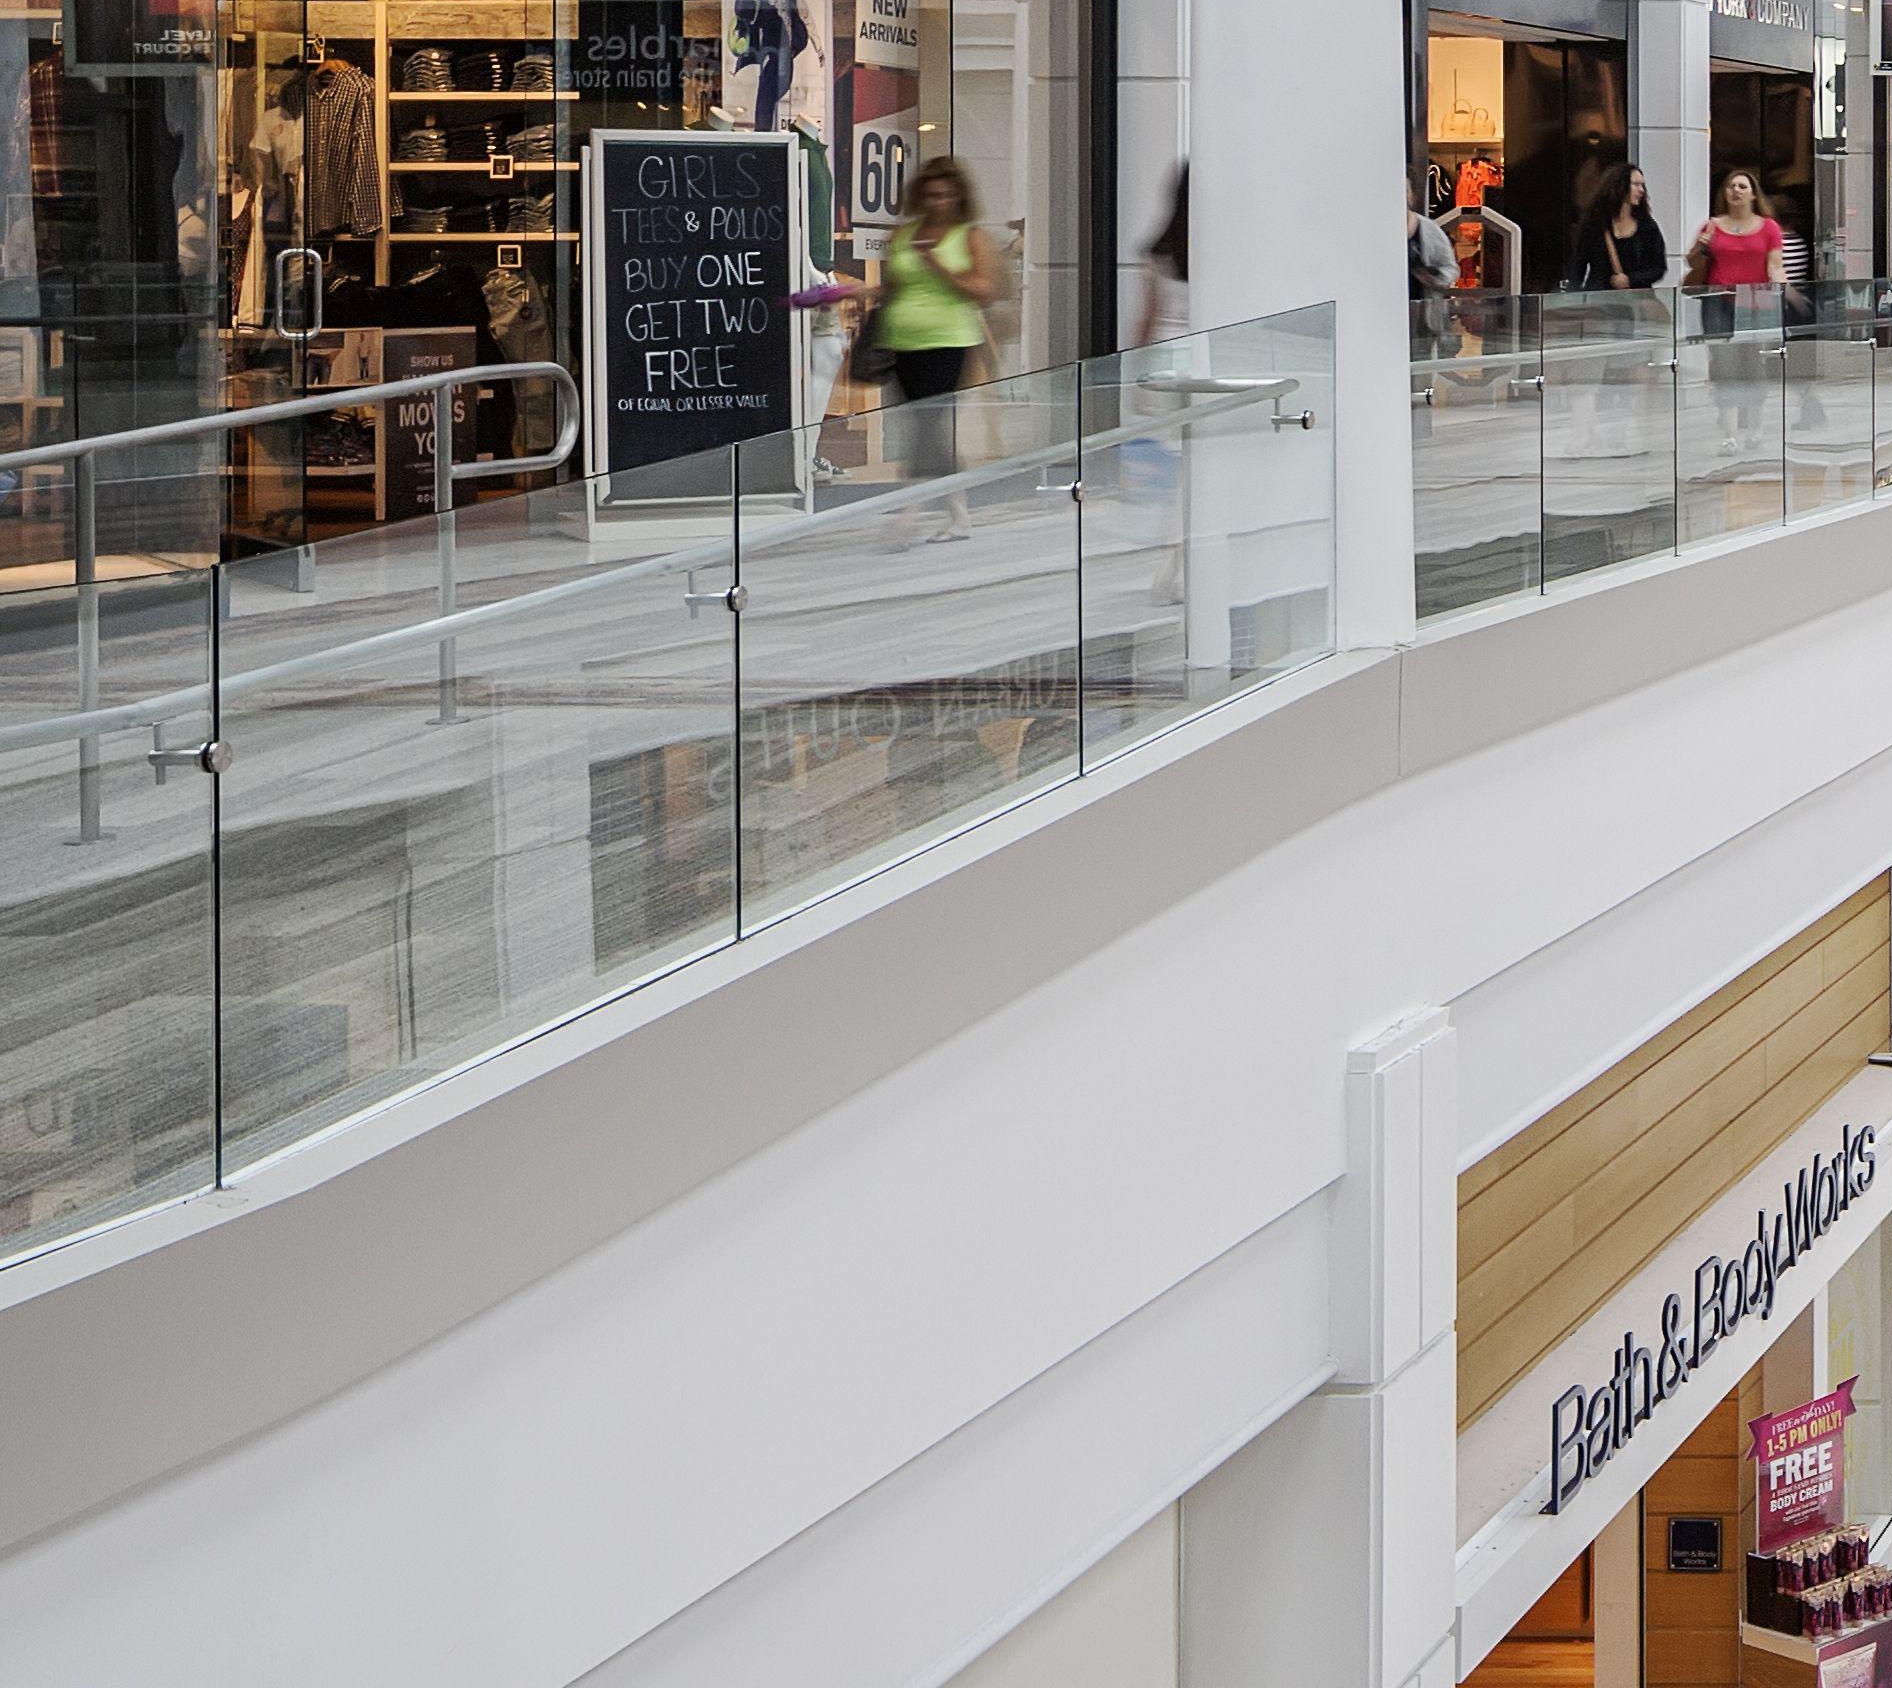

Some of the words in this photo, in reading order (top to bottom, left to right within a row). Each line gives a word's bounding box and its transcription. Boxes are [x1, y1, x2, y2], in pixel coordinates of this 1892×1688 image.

[859, 21, 918, 47] ARRIVALS
[638, 153, 760, 198] GIRLS
[612, 205, 683, 244] TEES
[684, 211, 700, 232] &
[710, 205, 784, 241] POLOS
[624, 255, 688, 293] BUY
[697, 251, 765, 288] ONE
[625, 300, 687, 342] GET
[695, 297, 769, 334] TWO
[410, 355, 439, 368] SHOW
[441, 354, 454, 365] US
[645, 344, 738, 392] FREE
[618, 398, 634, 411] OF
[637, 397, 673, 411] EQUAL
[676, 397, 694, 411] OR
[696, 395, 734, 410] LESSER
[736, 394, 769, 408] VALUE
[1551, 1331, 1653, 1515] Bath
[1657, 1293, 1689, 1400] &
[1693, 1209, 1783, 1369] Body
[1784, 1124, 1876, 1268] Works
[1766, 1433, 1787, 1458] 1-5
[1789, 1424, 1808, 1447] PM
[1810, 1410, 1841, 1438] ONLY!
[1769, 1440, 1834, 1491] FREE
[1769, 1492, 1797, 1512] BODY
[1799, 1479, 1834, 1502] CREAM
